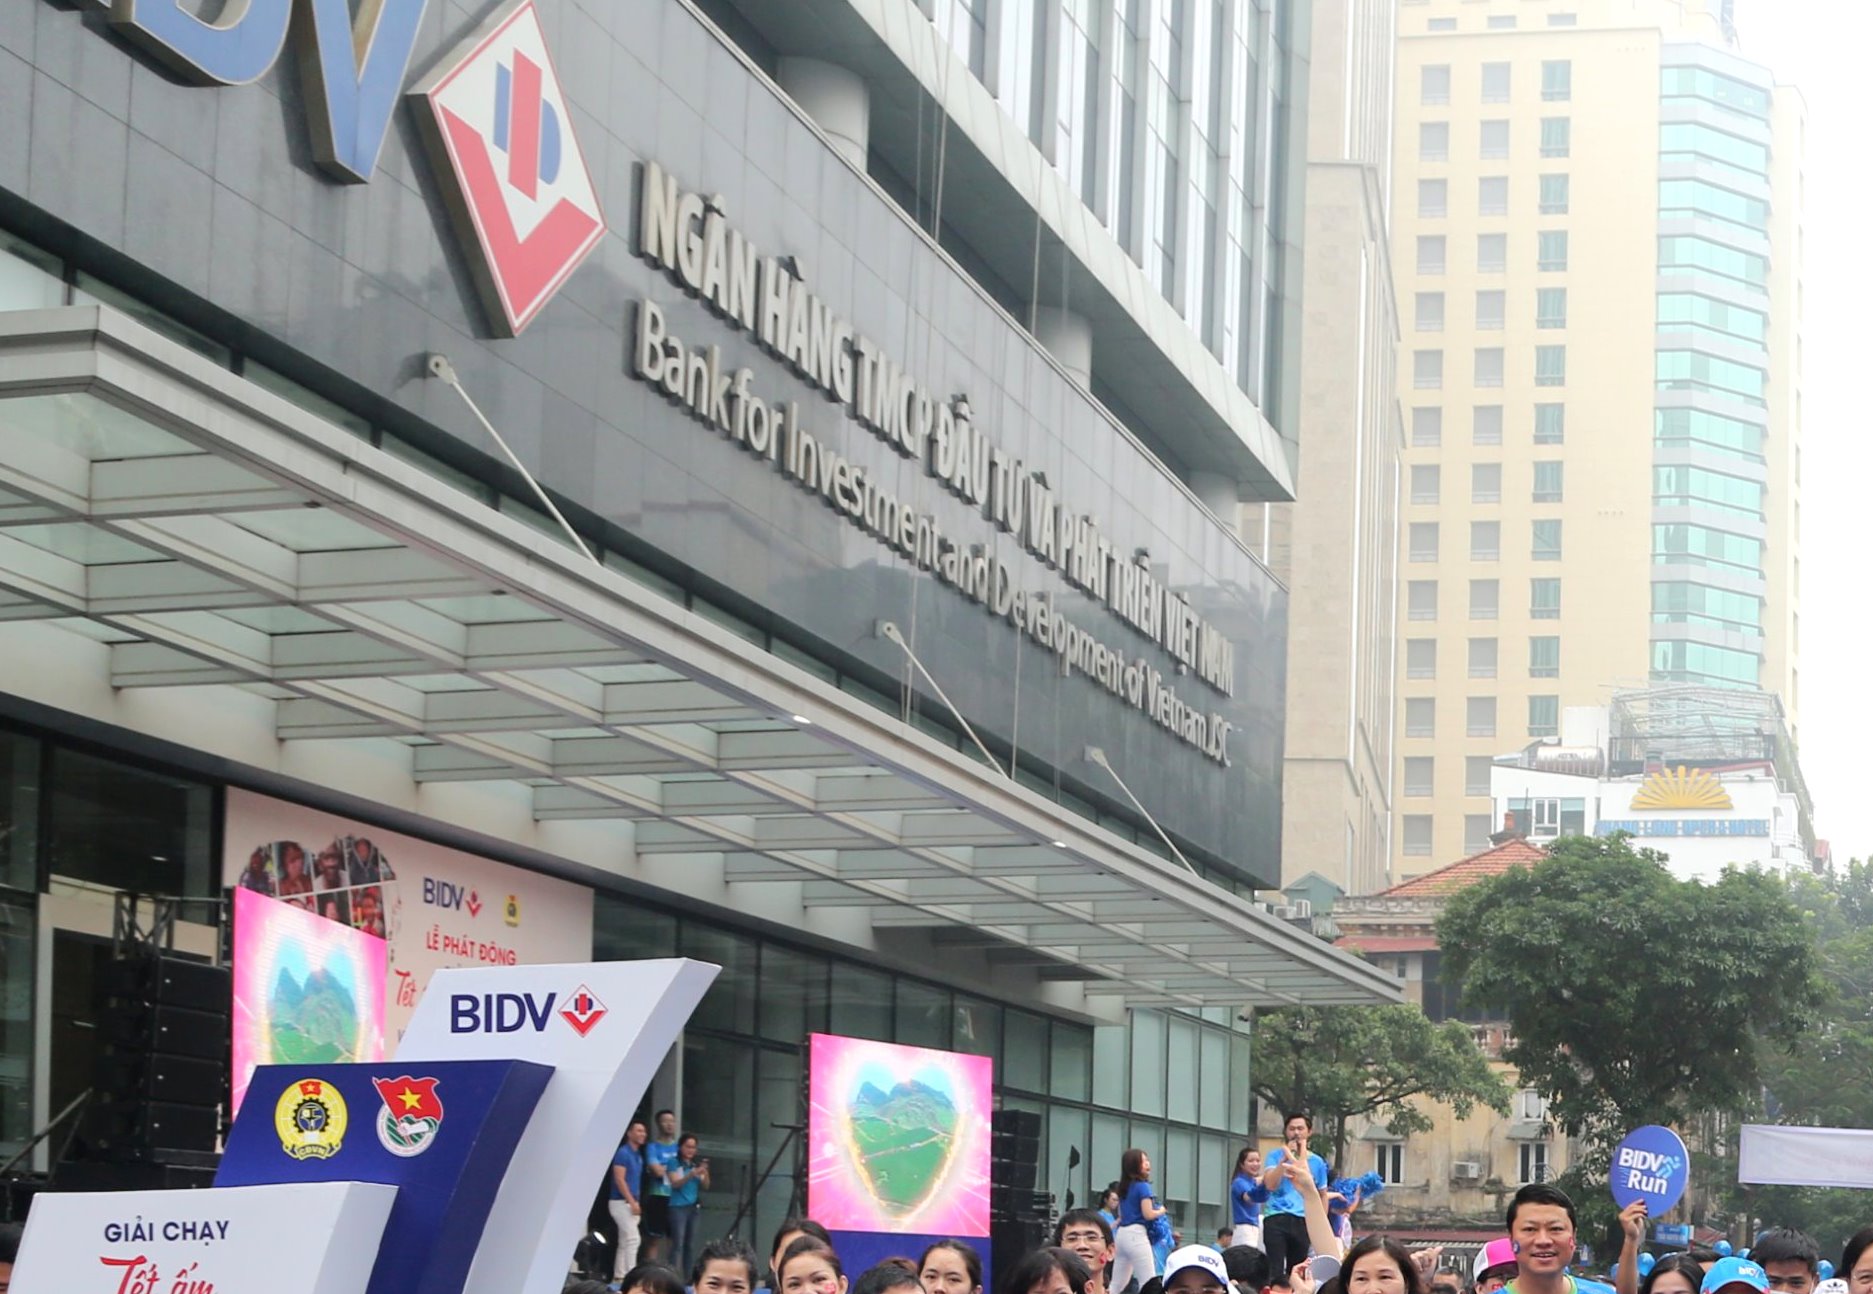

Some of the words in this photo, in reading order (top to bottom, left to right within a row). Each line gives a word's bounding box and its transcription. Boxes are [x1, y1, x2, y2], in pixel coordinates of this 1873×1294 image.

[641, 160, 757, 331] NGÂN
[757, 255, 856, 404] HÀNG
[854, 333, 933, 460] TMCP
[934, 394, 990, 506] ĐẦU
[989, 446, 1023, 534] TƯ
[1025, 470, 1056, 563] VÀ
[1056, 505, 1112, 602] PHÁT
[1200, 620, 1234, 698] NAM
[635, 299, 733, 441] Bank
[730, 367, 786, 464] for
[784, 400, 943, 575] Investment
[938, 541, 992, 604] and
[989, 553, 1125, 698] Development
[1123, 658, 1147, 709] of
[1144, 664, 1208, 747] Vietnam
[1206, 711, 1233, 768] JSC
[423, 877, 464, 911] BIDV
[426, 924, 440, 950] LỄ
[443, 934, 475, 958] PHÁT
[479, 941, 517, 965] ĐỘNG
[450, 992, 557, 1034] BIDV
[1618, 1147, 1665, 1173] BIDV
[1627, 1170, 1668, 1195] Run
[104, 1215, 154, 1242] GIẢI
[163, 1220, 230, 1246] CHẠY
[1198, 1254, 1219, 1267] BIDV
